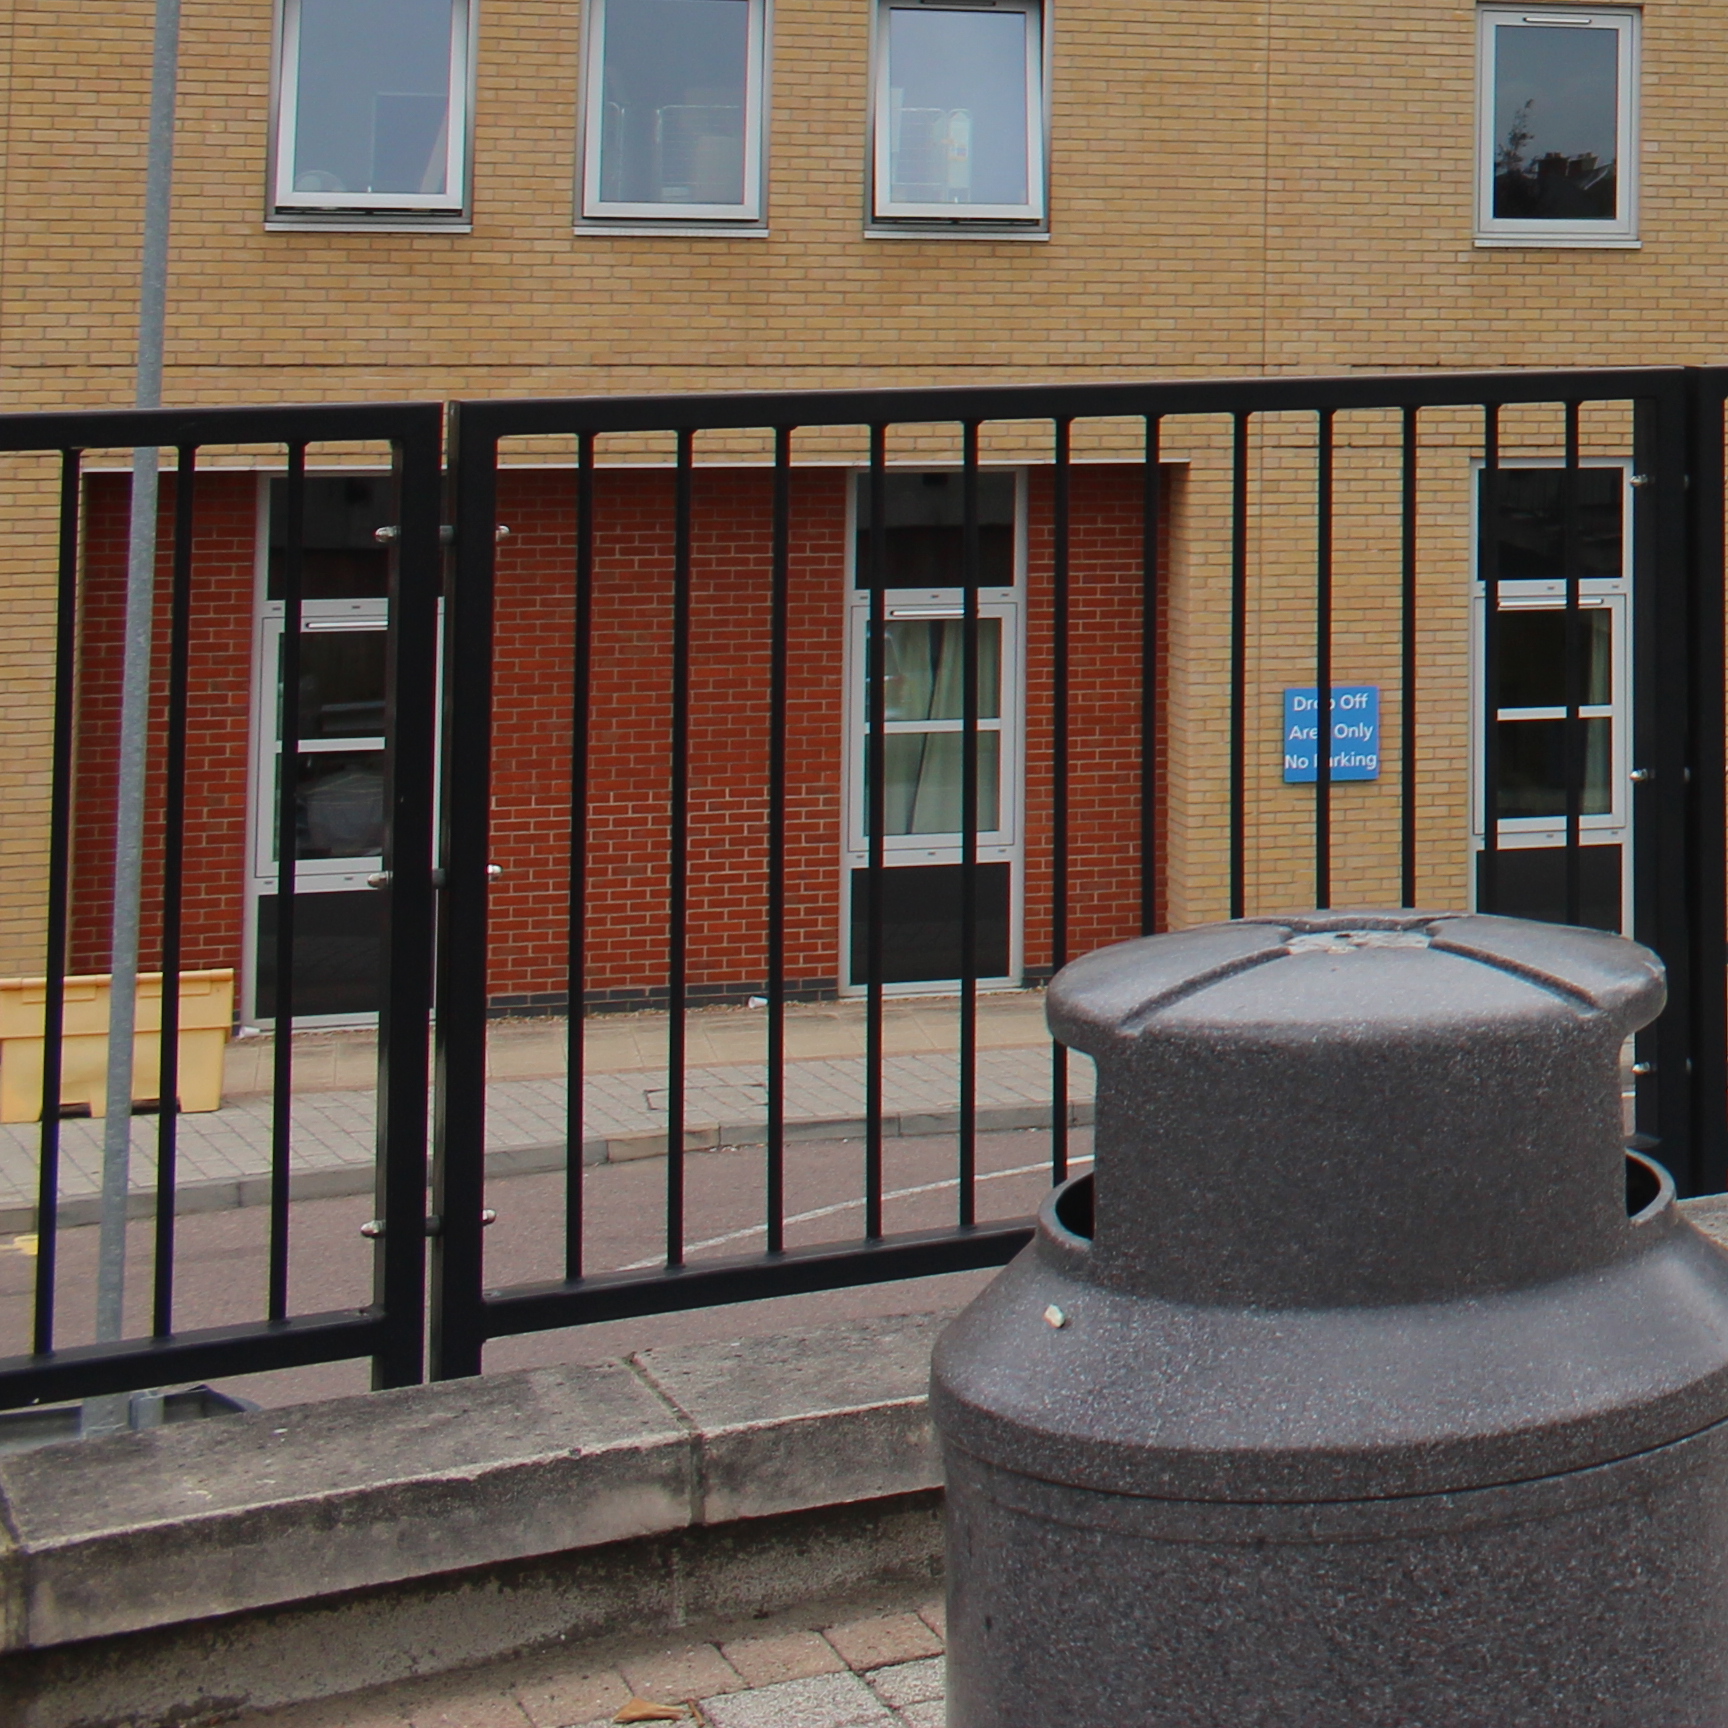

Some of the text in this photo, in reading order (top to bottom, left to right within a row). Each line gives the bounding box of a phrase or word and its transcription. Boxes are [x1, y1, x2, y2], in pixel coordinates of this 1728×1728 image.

[1340, 692, 1369, 710] Off
[1288, 721, 1374, 742] Are Only
[1284, 754, 1309, 769] No
